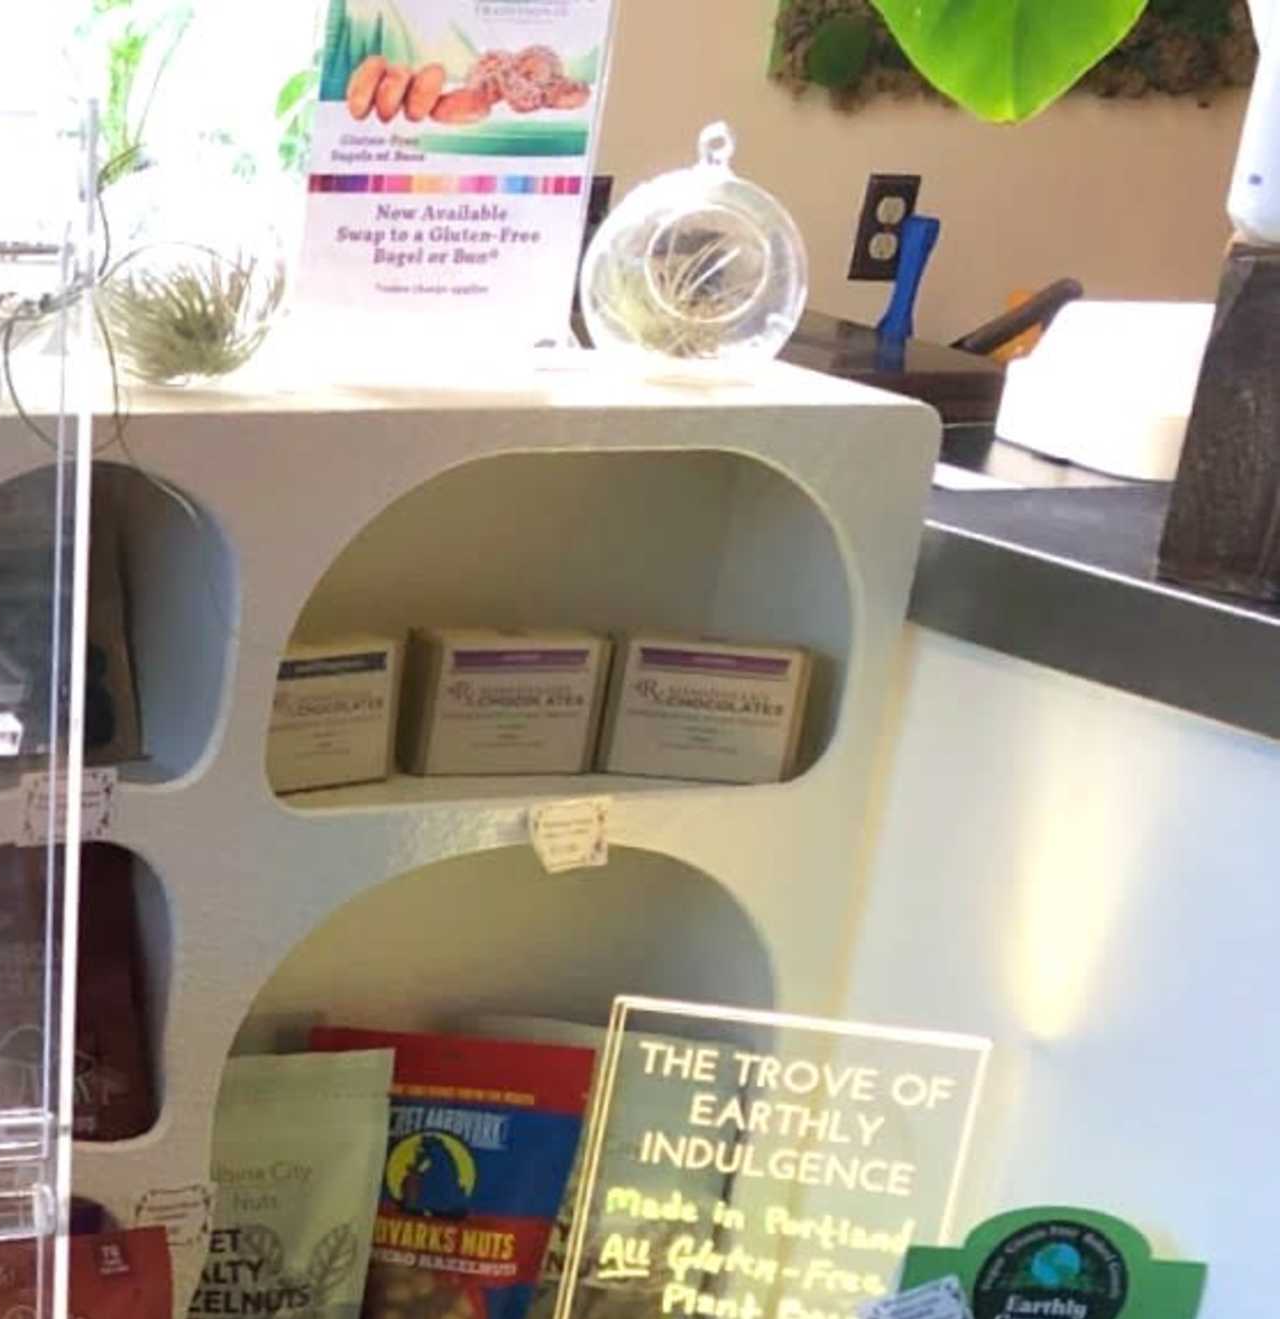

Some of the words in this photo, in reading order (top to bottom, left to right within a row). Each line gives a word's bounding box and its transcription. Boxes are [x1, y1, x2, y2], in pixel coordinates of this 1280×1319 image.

[421, 204, 508, 220] Available
[336, 227, 386, 245] Swap
[390, 228, 409, 243] to
[413, 231, 423, 242] a
[429, 227, 541, 243] Gluten-Free
[372, 249, 424, 268] Bagel
[428, 253, 446, 264] or
[640, 1041, 718, 1083] THE
[733, 1051, 878, 1101] TROVE
[891, 1073, 955, 1110] OF
[688, 1092, 885, 1148] EARTHLY
[640, 1131, 915, 1196] INDULGENCE
[606, 1187, 699, 1223] Made
[713, 1201, 745, 1231] in
[765, 1205, 915, 1255] Portland
[461, 1229, 516, 1260] NUTS
[667, 1235, 886, 1296] Gluten-Free
[188, 1283, 311, 1315] ZELNUTS
[1004, 1295, 1087, 1319] Earthly
